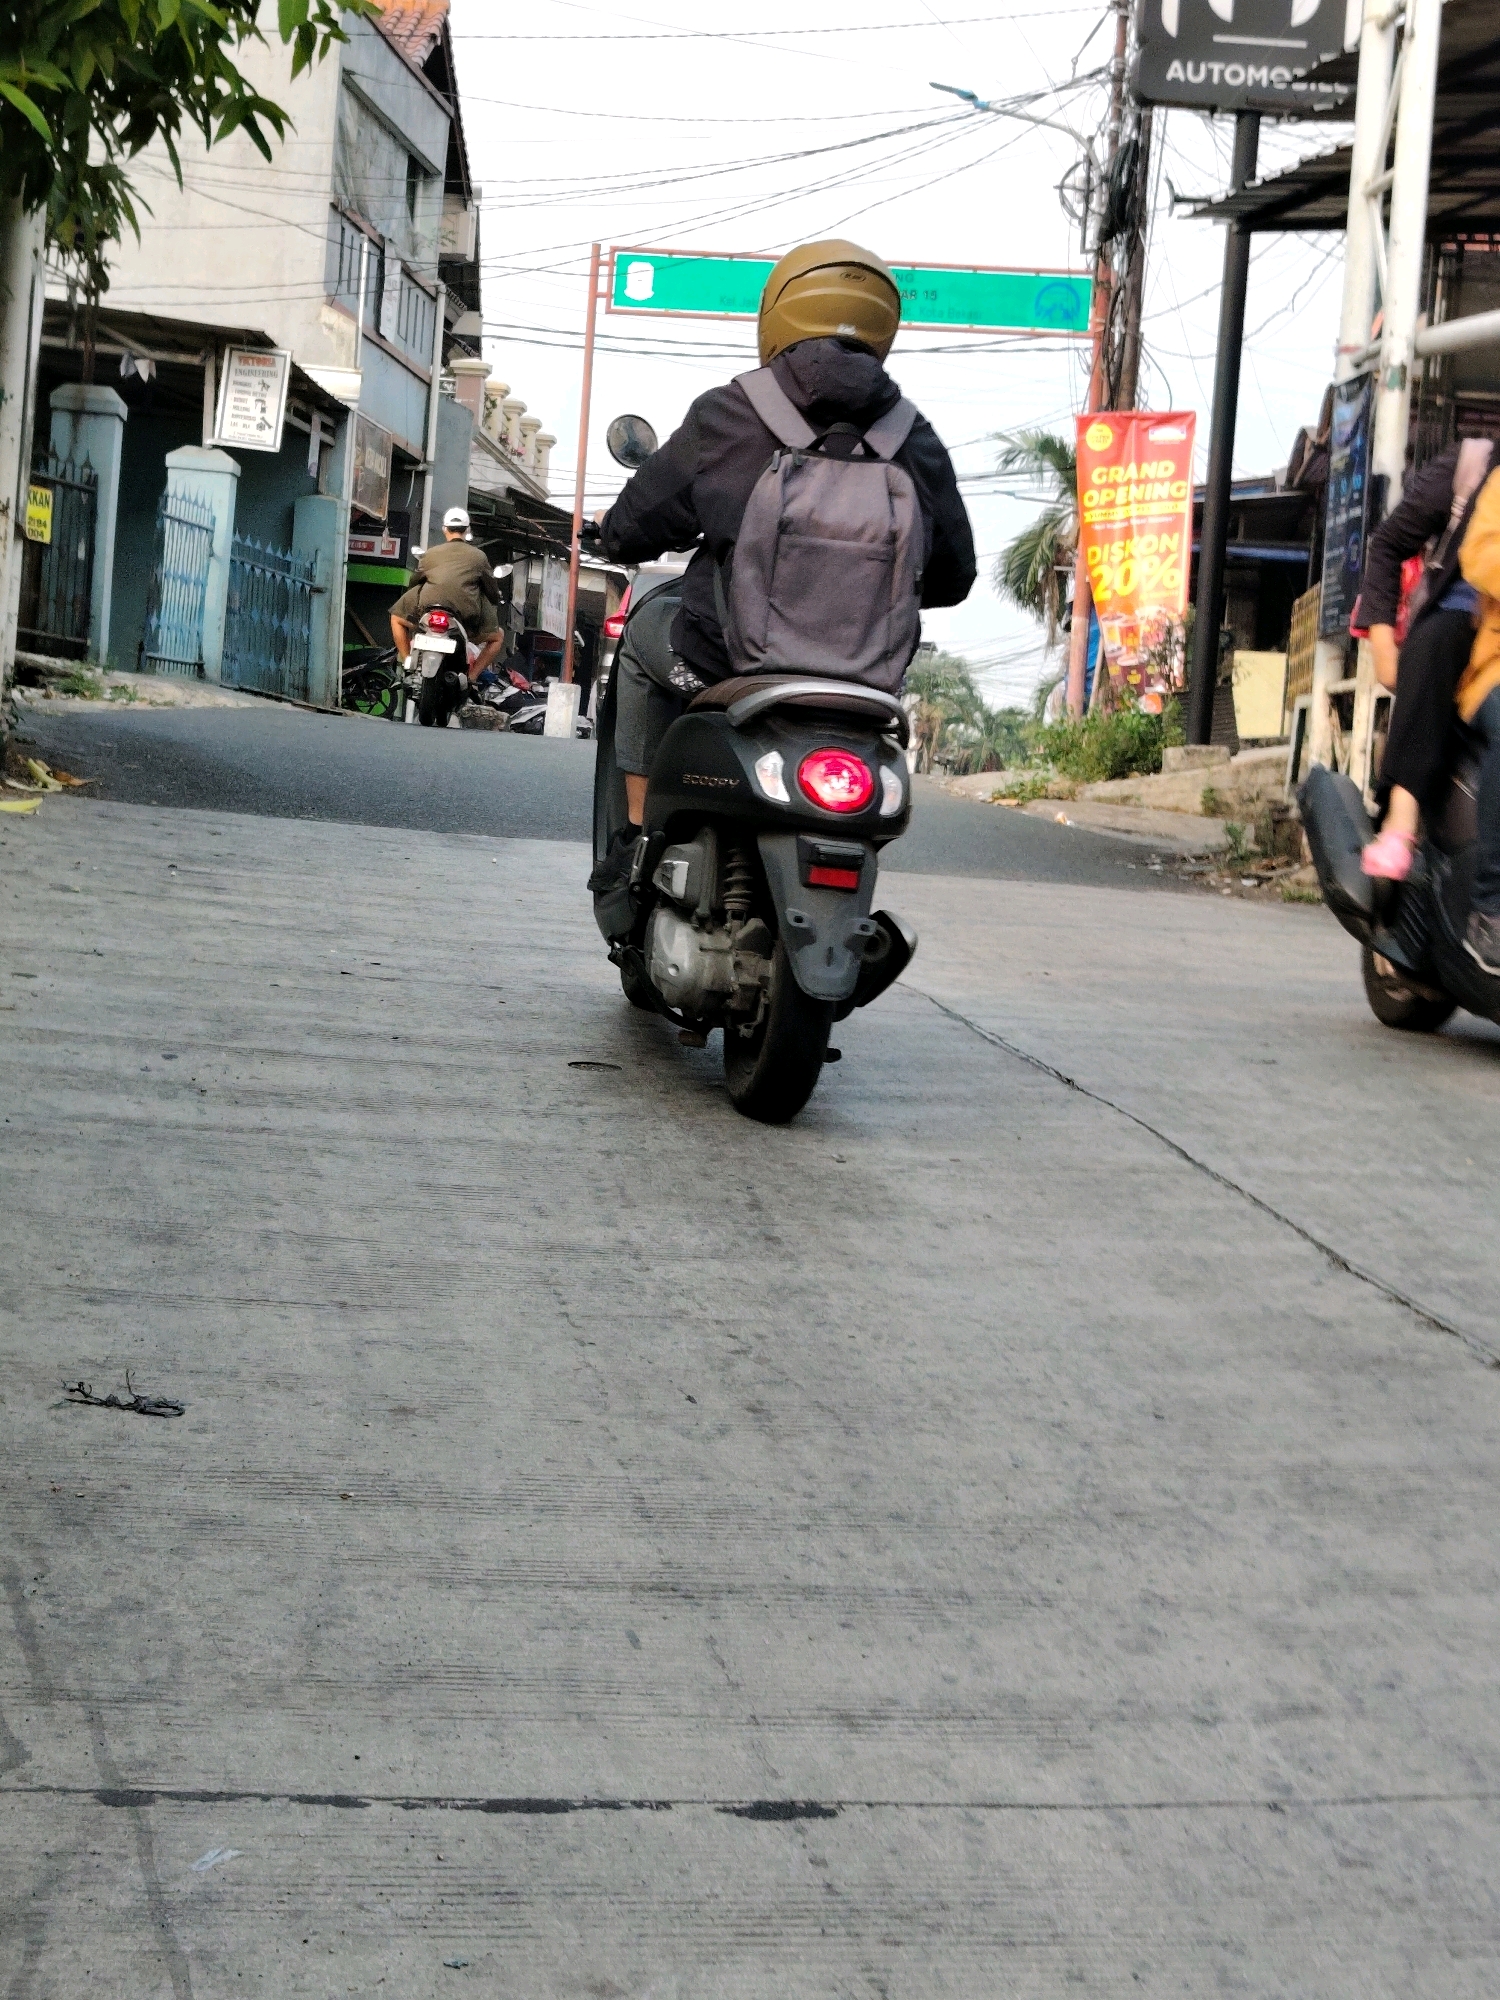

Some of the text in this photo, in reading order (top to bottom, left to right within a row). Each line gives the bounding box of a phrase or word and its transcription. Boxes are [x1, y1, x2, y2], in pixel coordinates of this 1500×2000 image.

[1091, 460, 1175, 485] GRAND
[1083, 480, 1188, 508] OPENING
[1087, 532, 1180, 566] DISKON
[1091, 553, 1182, 602] 20%
